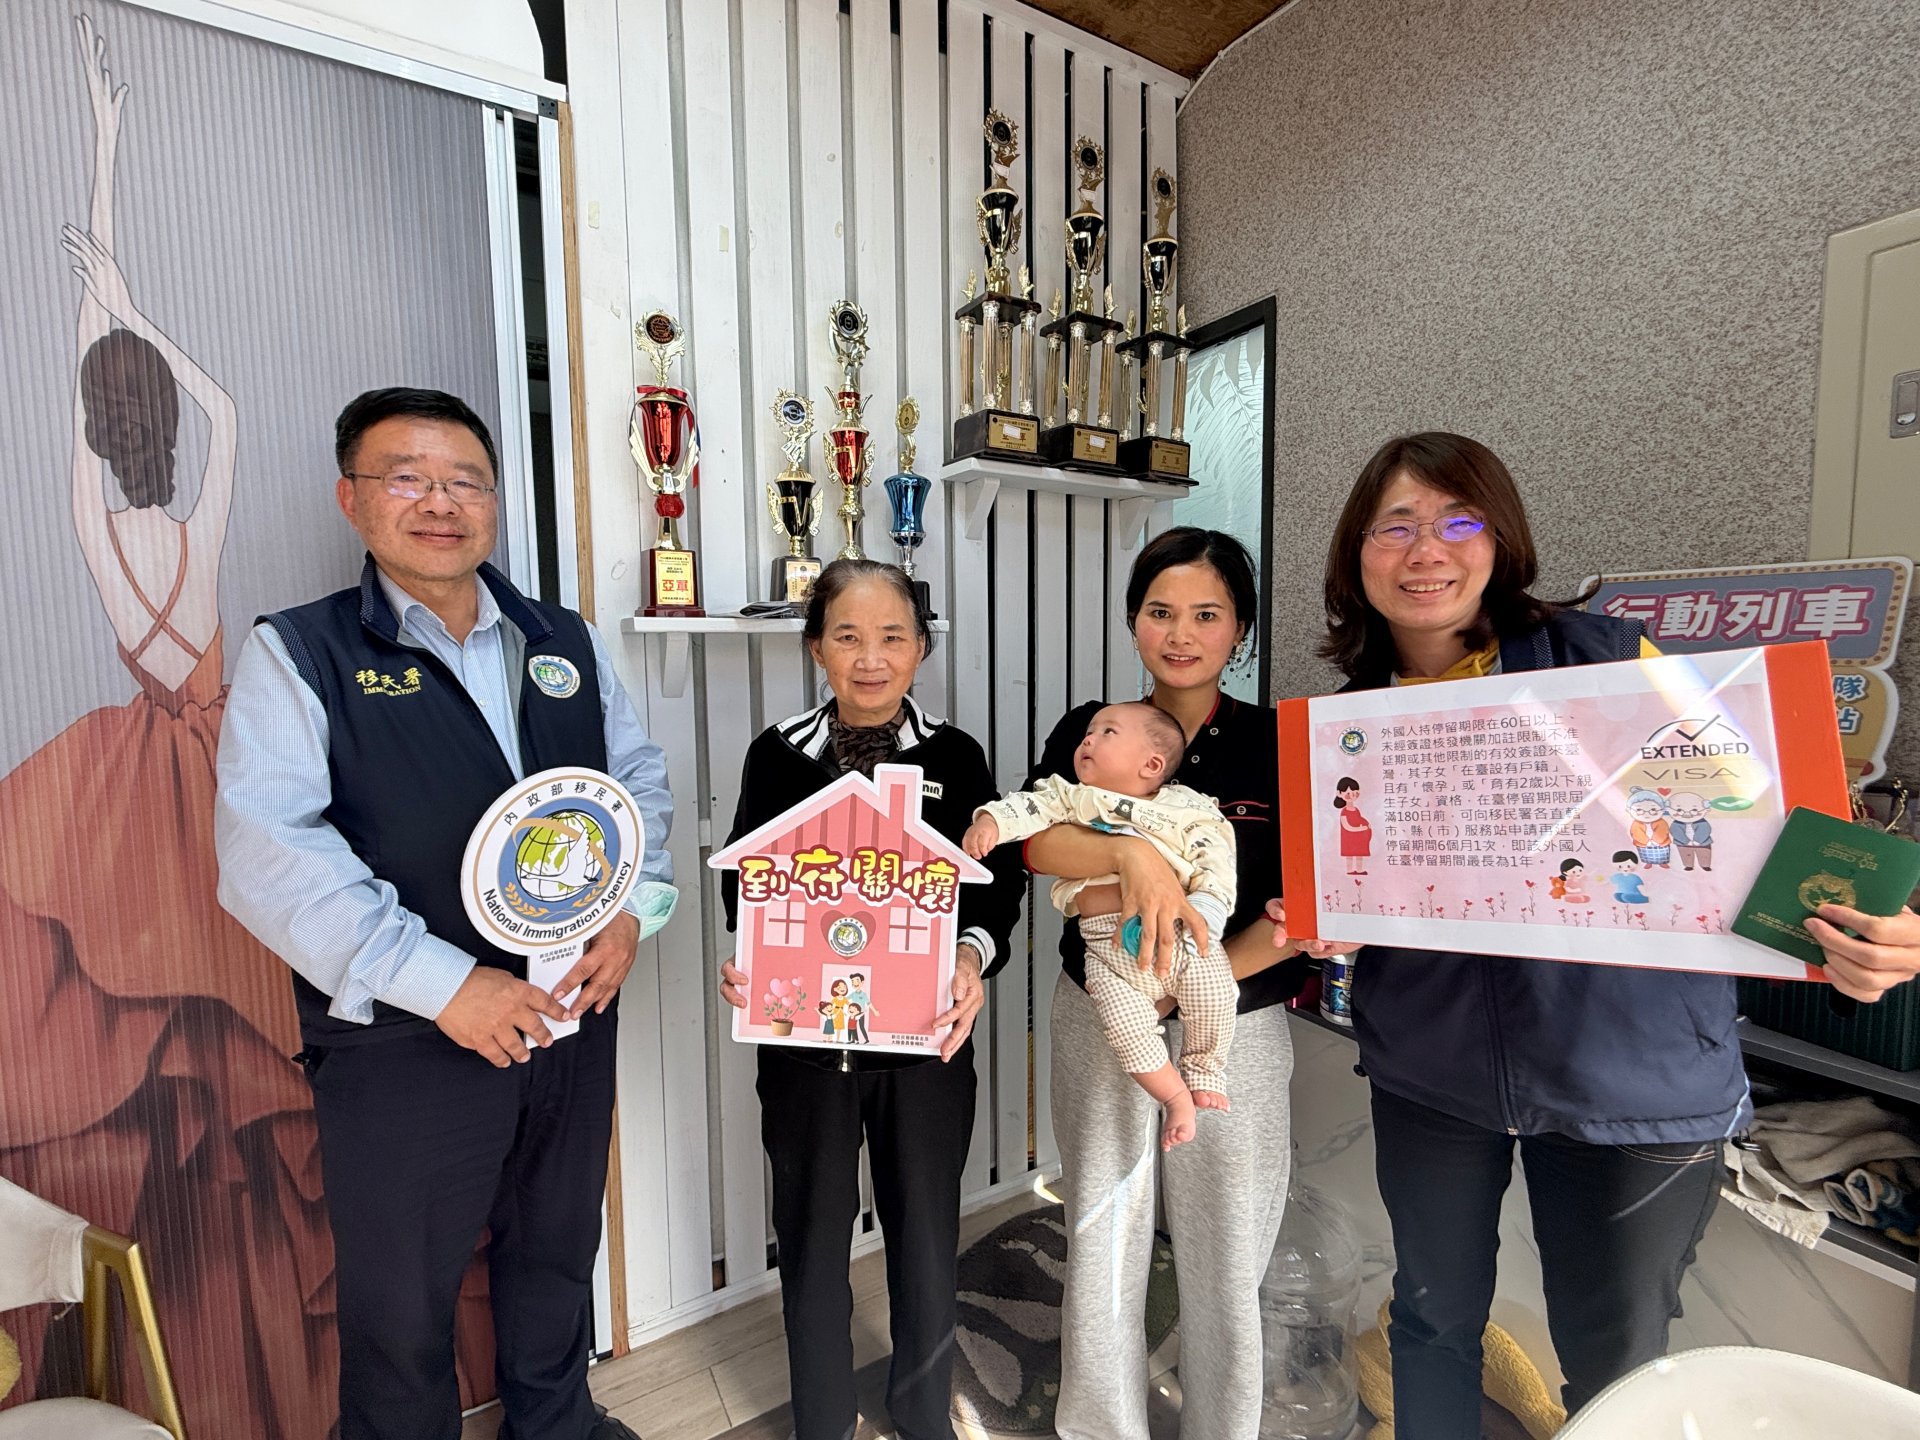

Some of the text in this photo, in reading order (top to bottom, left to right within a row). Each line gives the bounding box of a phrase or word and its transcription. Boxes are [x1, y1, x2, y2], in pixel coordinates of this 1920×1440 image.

[355, 667, 422, 690] 移民署
[363, 685, 422, 697] IMMRATION
[1641, 742, 1750, 760] EXTENDED
[1643, 766, 1740, 781] VISA
[739, 845, 960, 914] 到府關懷
[483, 861, 632, 939] National Immigration Agency
